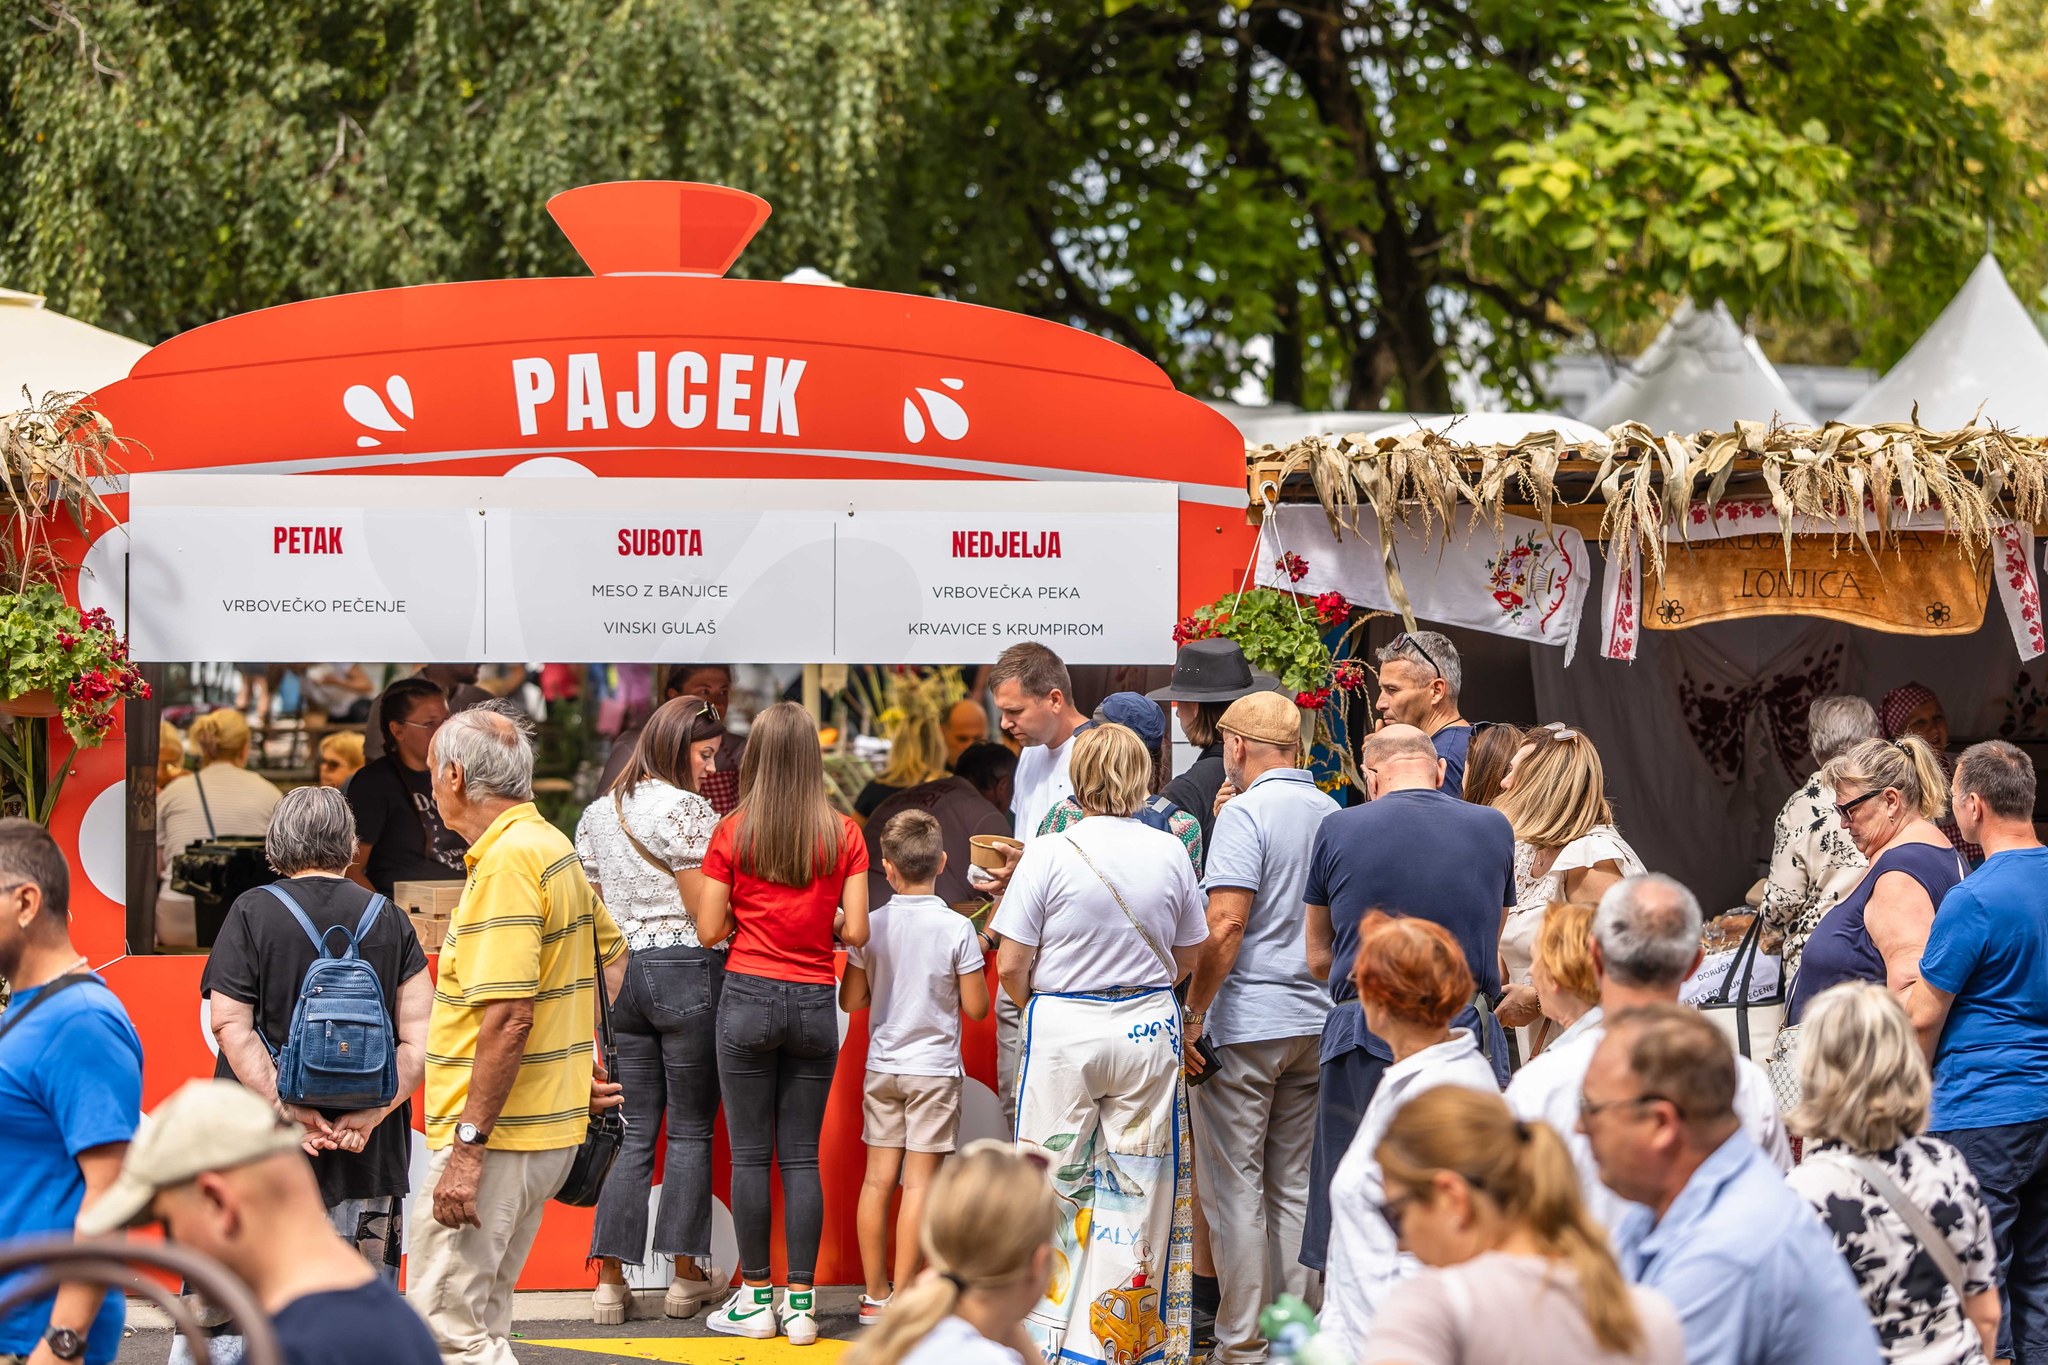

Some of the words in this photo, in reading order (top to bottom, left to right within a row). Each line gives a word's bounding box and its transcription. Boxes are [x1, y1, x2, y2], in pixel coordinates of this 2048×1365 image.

[511, 350, 807, 437] PAJCEK
[273, 526, 344, 554] PETAK
[617, 528, 703, 556] SUBOTA
[951, 530, 1062, 558] NEDJELJA
[592, 584, 638, 597] MESO
[643, 584, 653, 597] Z
[659, 584, 728, 597] BANJICE
[931, 584, 1033, 599] VRBOVEČKA
[1038, 587, 1081, 599] PEKA
[1741, 569, 1863, 599] LONJICA
[222, 597, 327, 613] VRBOVEČKO
[332, 598, 406, 613] PEČENJE
[603, 621, 656, 634] VINSKI
[661, 619, 717, 635] GULAŠ
[908, 623, 987, 636] KRVAVICE
[992, 623, 1002, 636] S
[1006, 623, 1104, 636] KRUMPIROM
[1697, 962, 1732, 981] DORUČA
[1747, 983, 1775, 1000] EČENE
